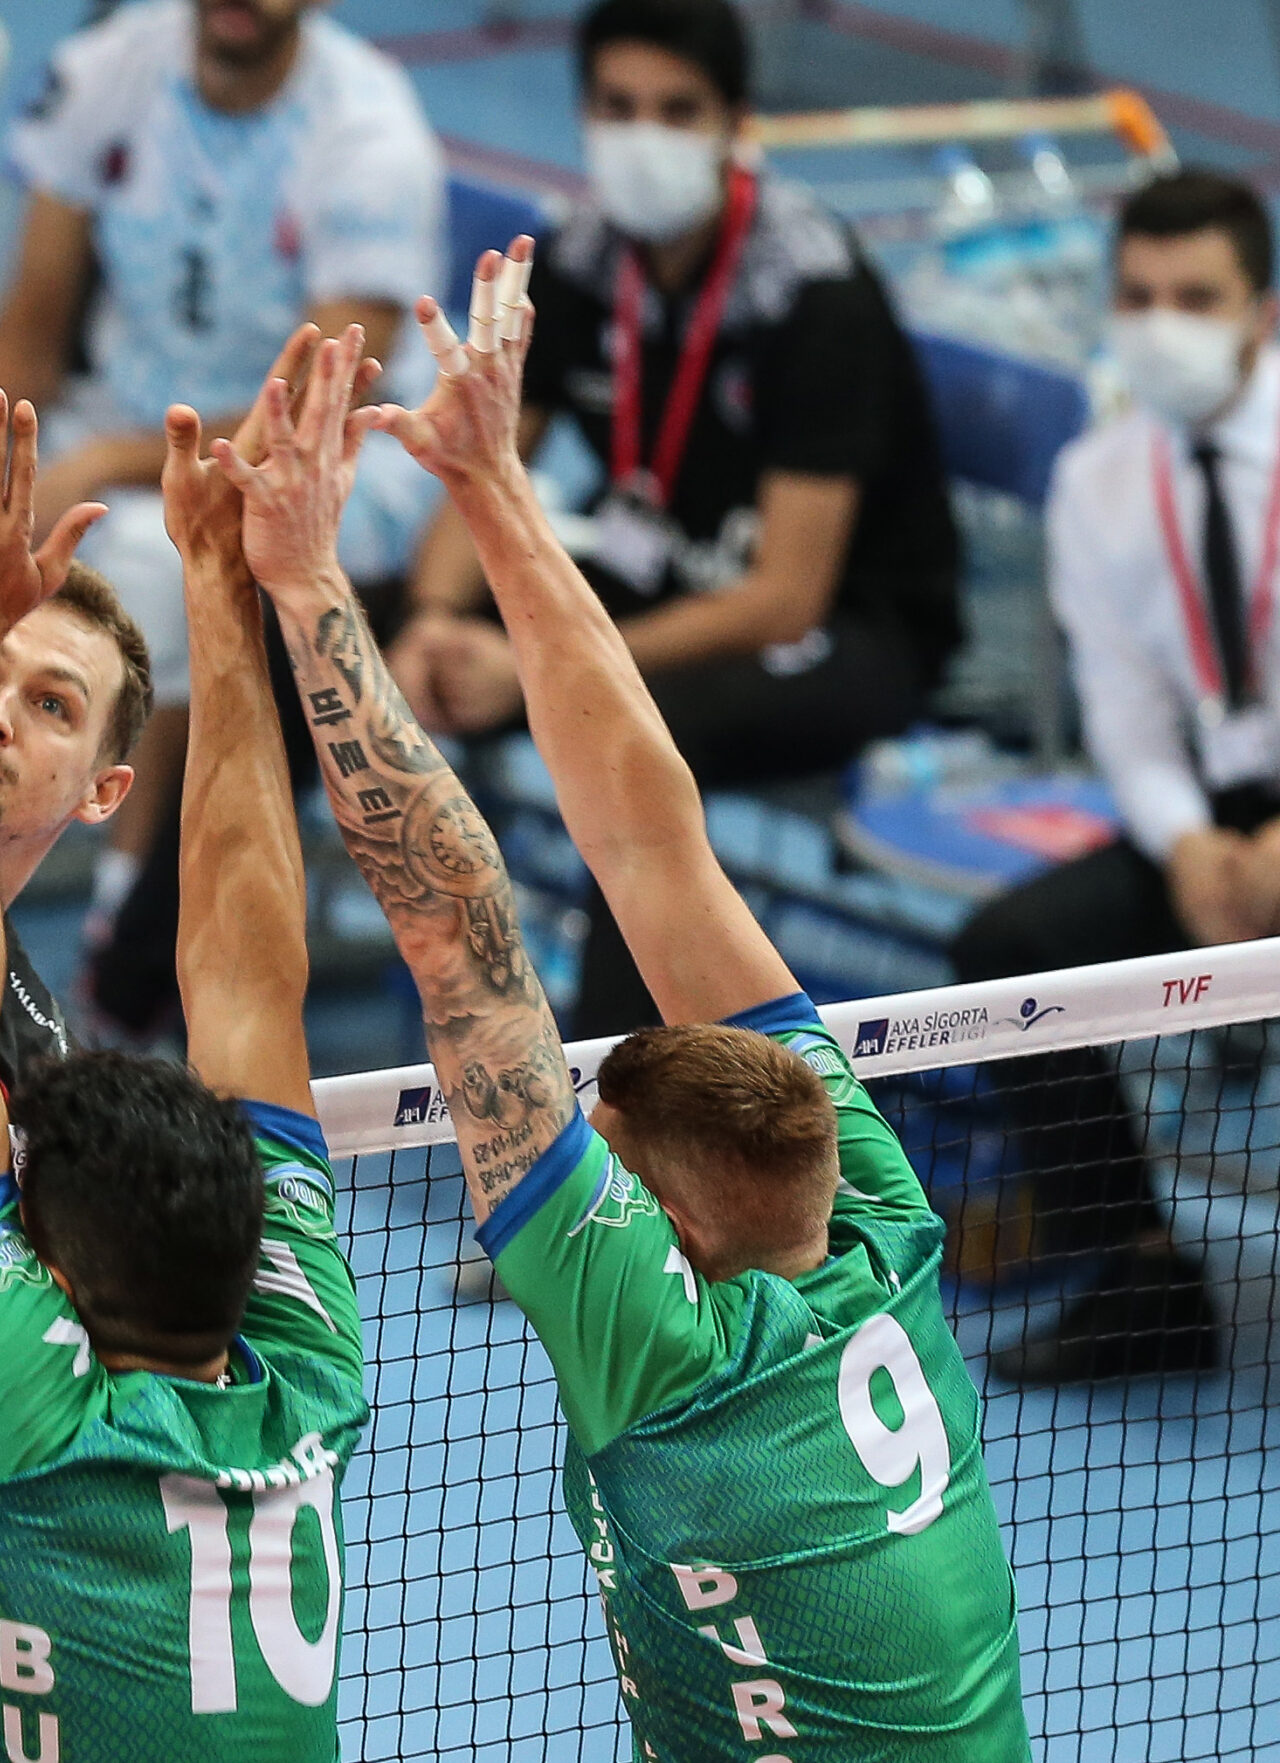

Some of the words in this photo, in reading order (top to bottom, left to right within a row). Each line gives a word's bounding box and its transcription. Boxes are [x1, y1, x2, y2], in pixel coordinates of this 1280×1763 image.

[889, 1018, 919, 1036] AXA
[922, 1007, 989, 1032] SİGORTA
[1162, 974, 1213, 1007] TVF
[837, 1312, 951, 1536] 9
[159, 1470, 342, 1715] 10
[669, 1562, 799, 1763] BUR
